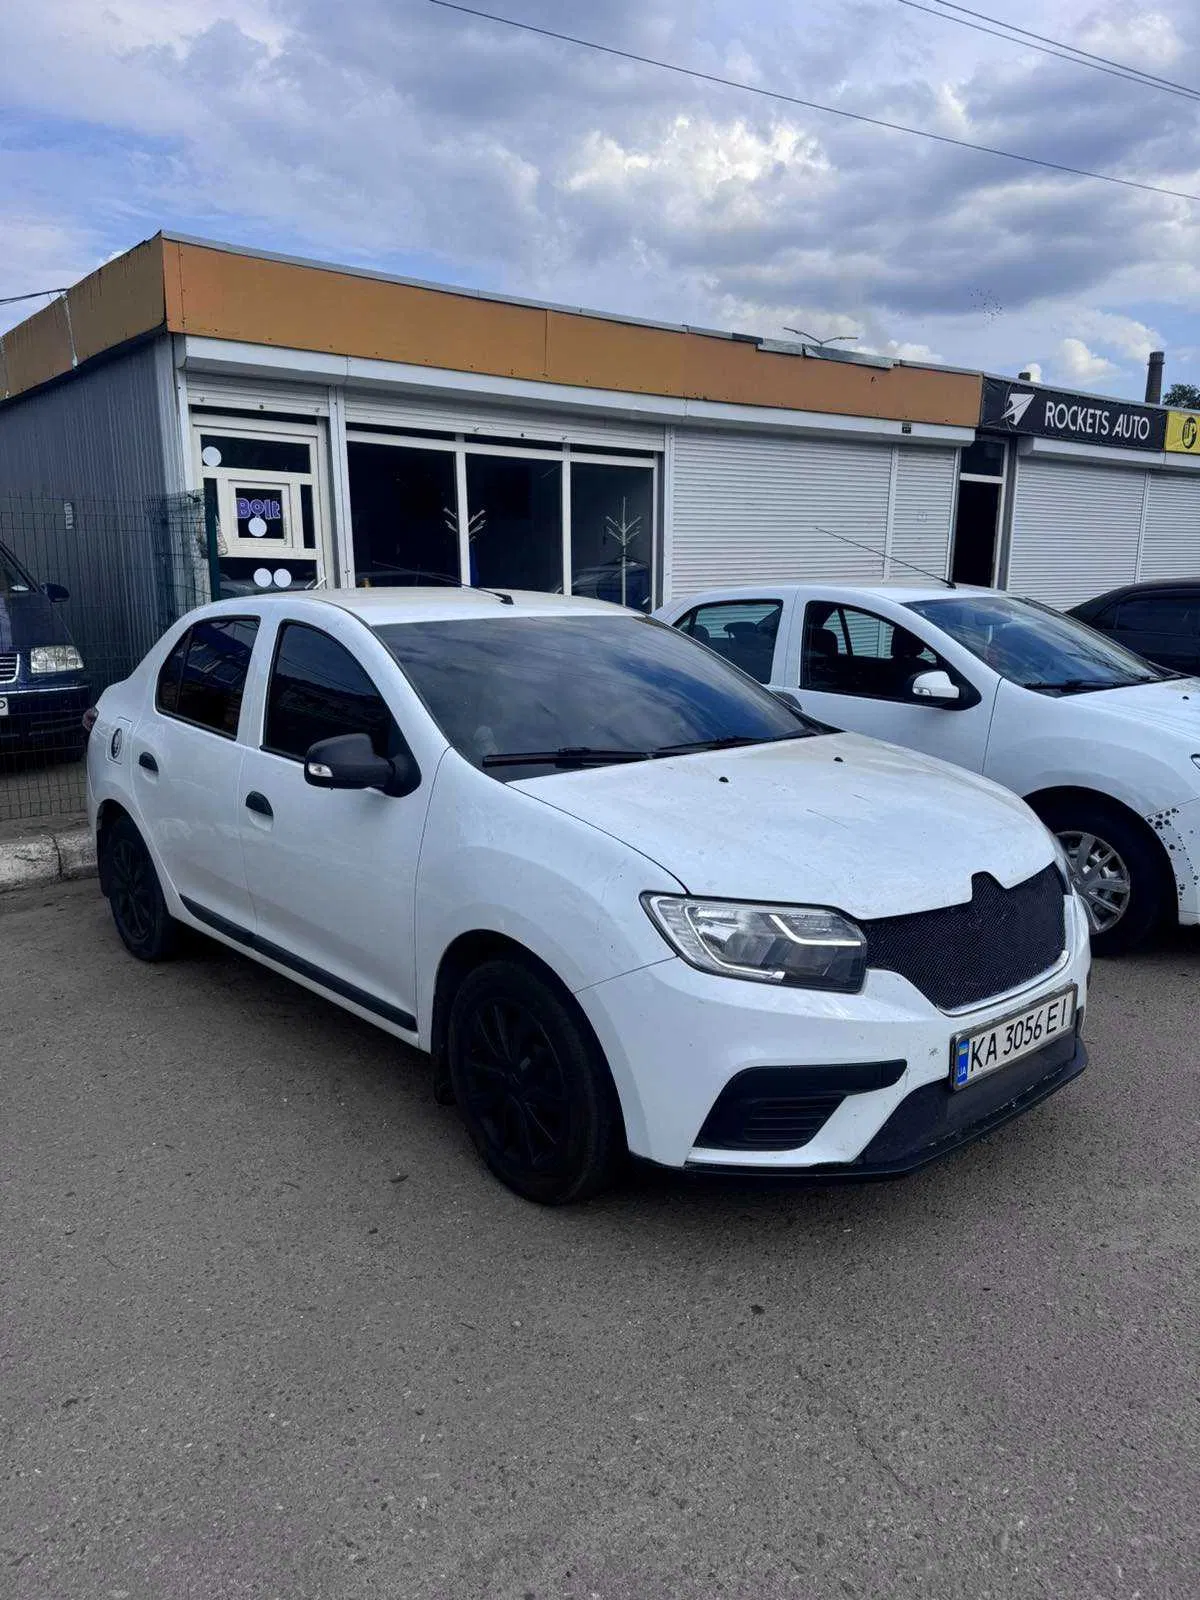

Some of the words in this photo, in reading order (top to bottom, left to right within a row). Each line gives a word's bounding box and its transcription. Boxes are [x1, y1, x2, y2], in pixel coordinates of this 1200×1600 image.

[1044, 401, 1110, 435] ROCKETS
[1112, 413, 1150, 440] AUTO
[232, 498, 280, 519] Bolt
[970, 1032, 997, 1071] KA
[1003, 1010, 1043, 1055] 3056
[1046, 999, 1066, 1034] EI
